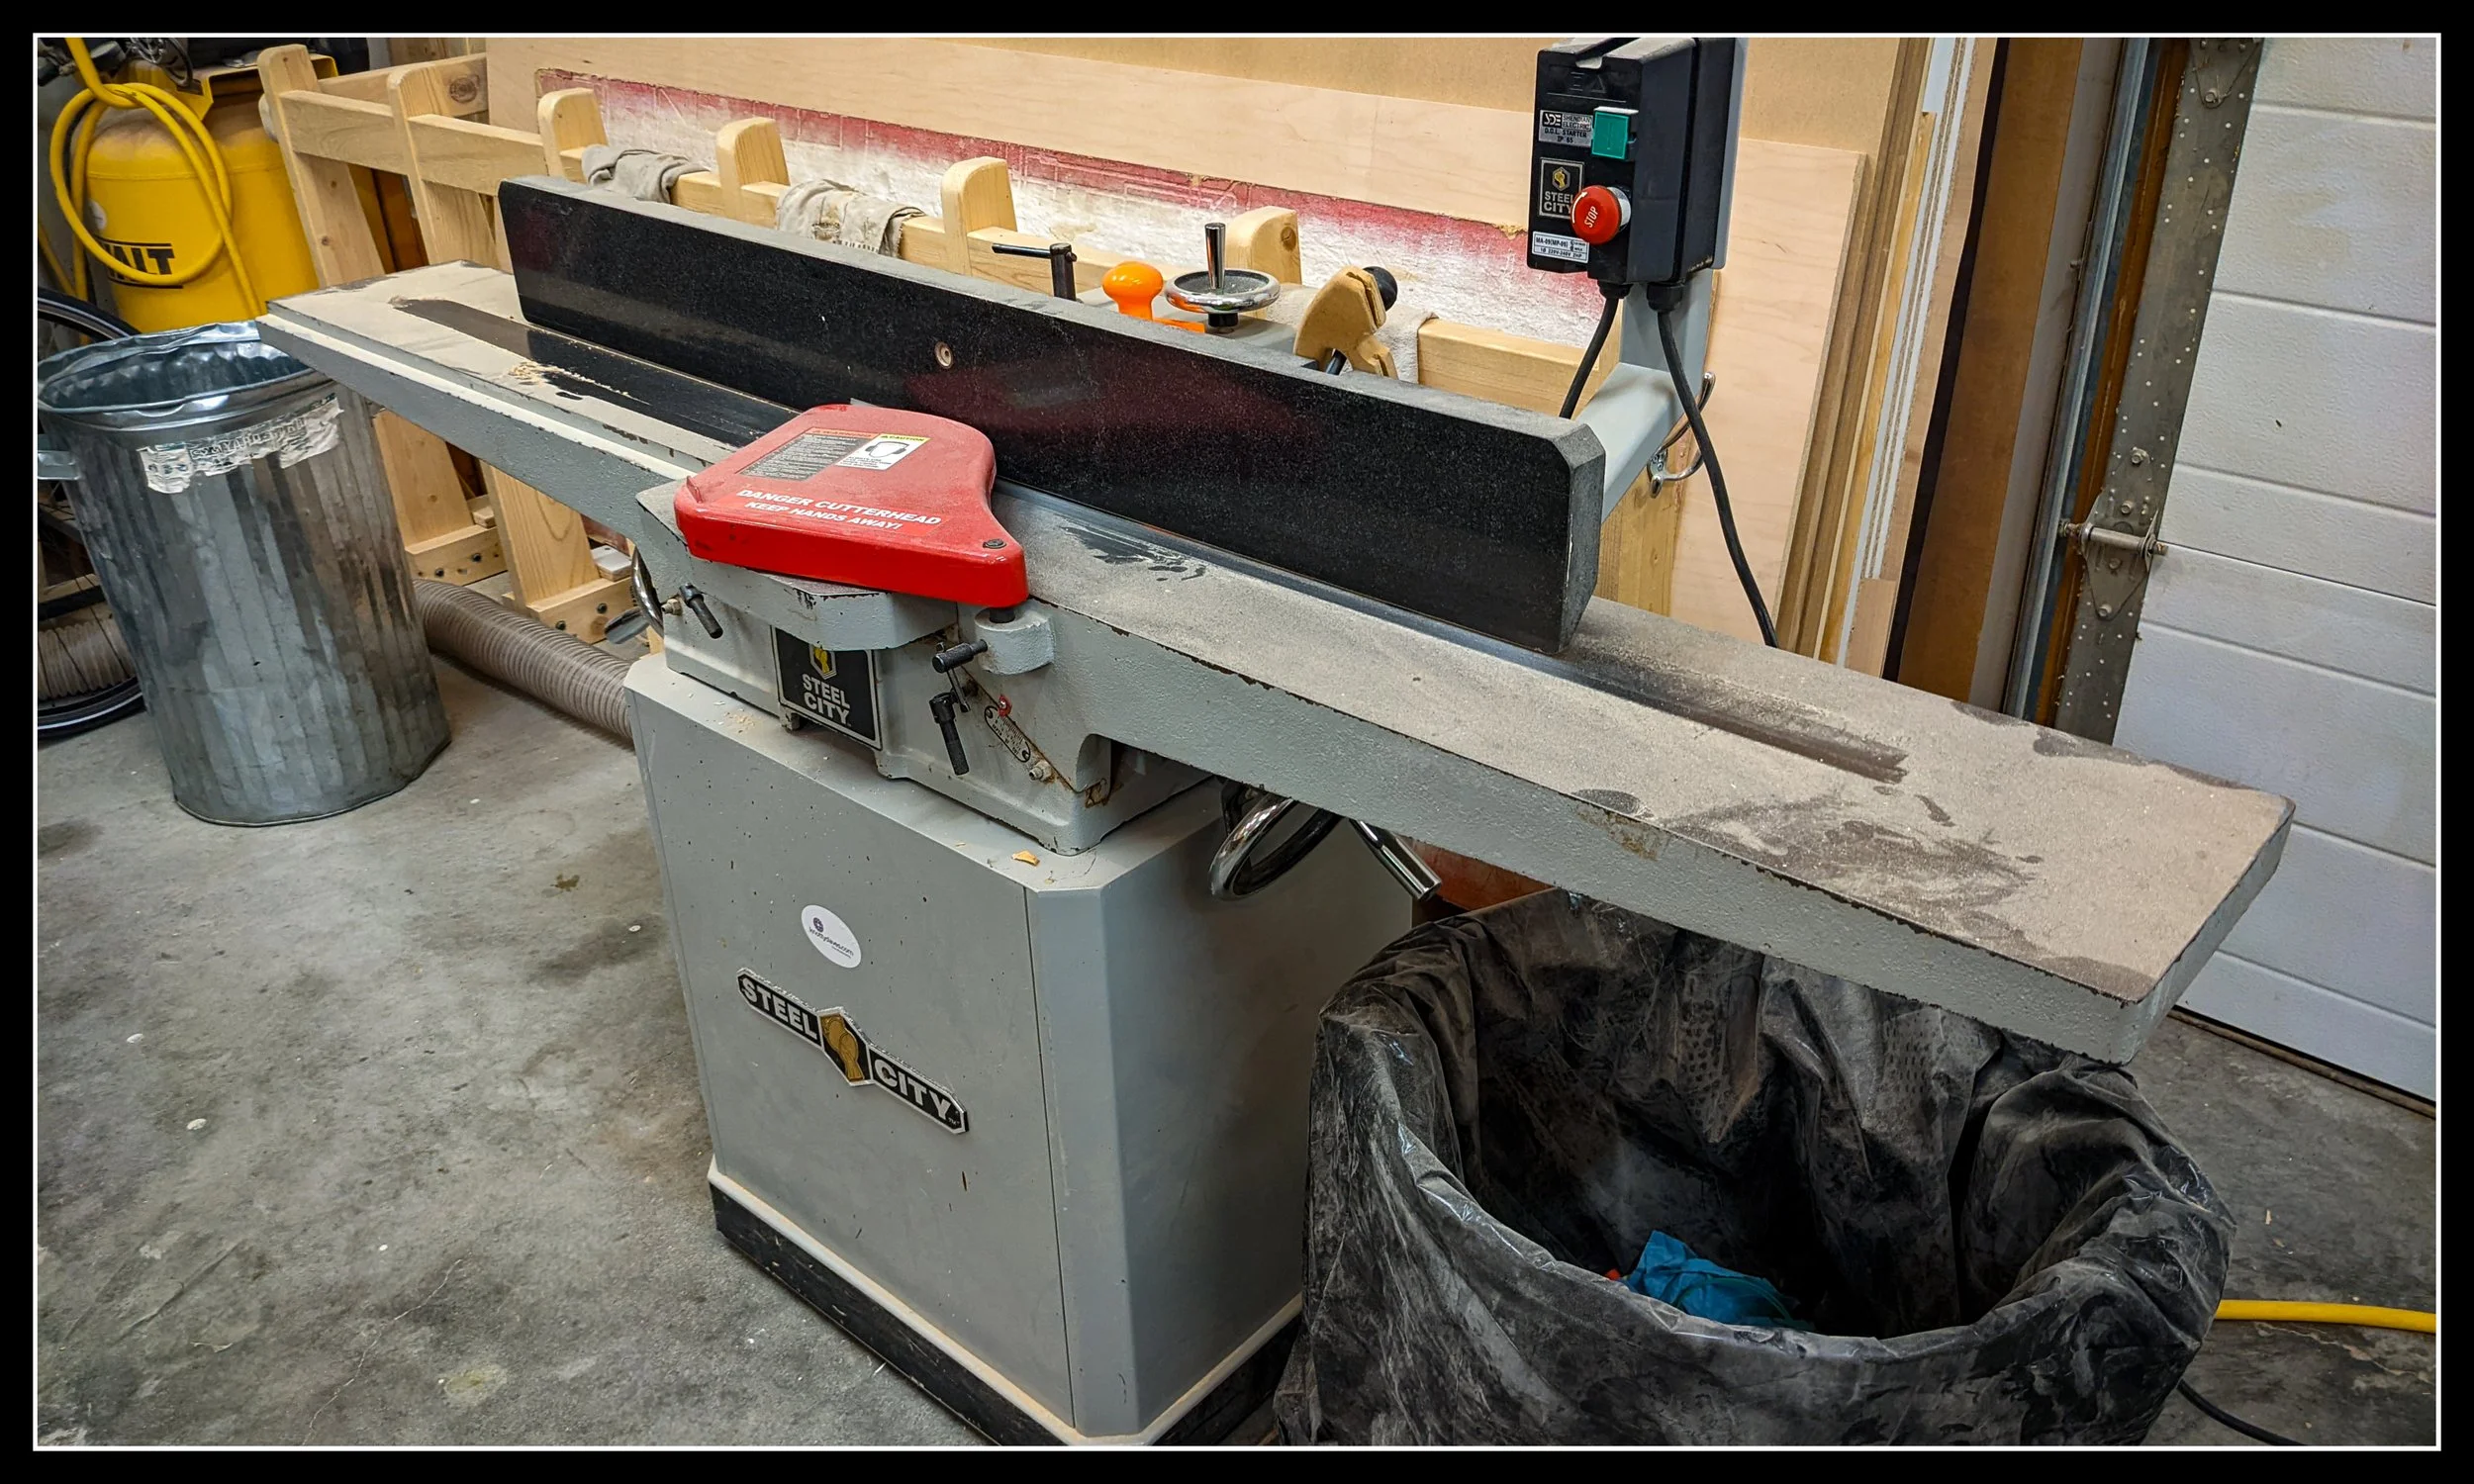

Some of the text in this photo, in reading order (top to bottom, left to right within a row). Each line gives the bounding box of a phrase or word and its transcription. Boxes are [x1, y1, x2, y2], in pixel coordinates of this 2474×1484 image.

[1583, 206, 1599, 229] STOP
[736, 489, 942, 525] DANGER CUTTERHEAD
[744, 501, 904, 530] KEEP HANDS AWAY!
[802, 673, 851, 709] STEEL
[804, 692, 850, 725] CITY
[742, 976, 953, 1122] STEEL CITY
